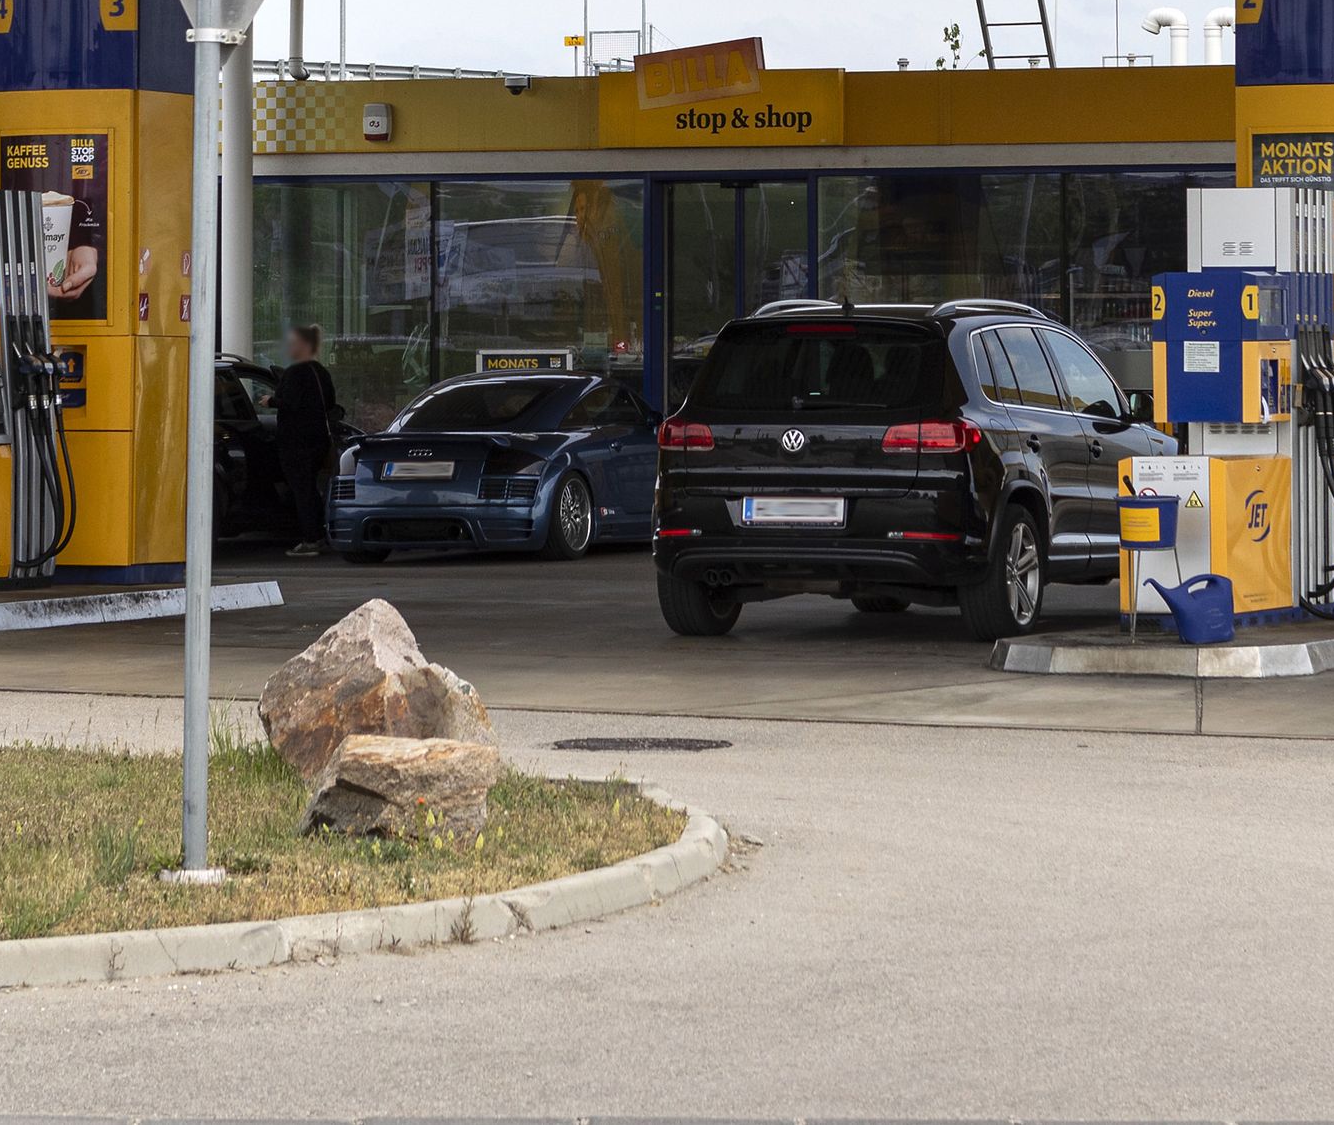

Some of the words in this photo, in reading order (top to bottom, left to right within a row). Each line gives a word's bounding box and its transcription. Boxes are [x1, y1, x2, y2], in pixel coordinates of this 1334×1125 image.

[642, 49, 753, 100] BILLA
[675, 107, 727, 134] stop
[730, 107, 750, 129] &
[754, 104, 813, 133] shop
[71, 138, 95, 147] BILLA
[7, 145, 46, 157] KAFFEE
[71, 147, 95, 155] STOP
[1260, 142, 1334, 158] MONATS
[7, 157, 49, 169] GENUSS
[71, 154, 95, 163] SHOP
[1261, 158, 1332, 175] AKTION
[1187, 288, 1215, 298] Diesel
[1154, 293, 1162, 311] 2
[1246, 293, 1253, 311] 1
[1187, 308, 1213, 319] Super
[1187, 318, 1217, 328] Super+
[487, 358, 539, 369] MONATS
[1247, 503, 1269, 529] JET
